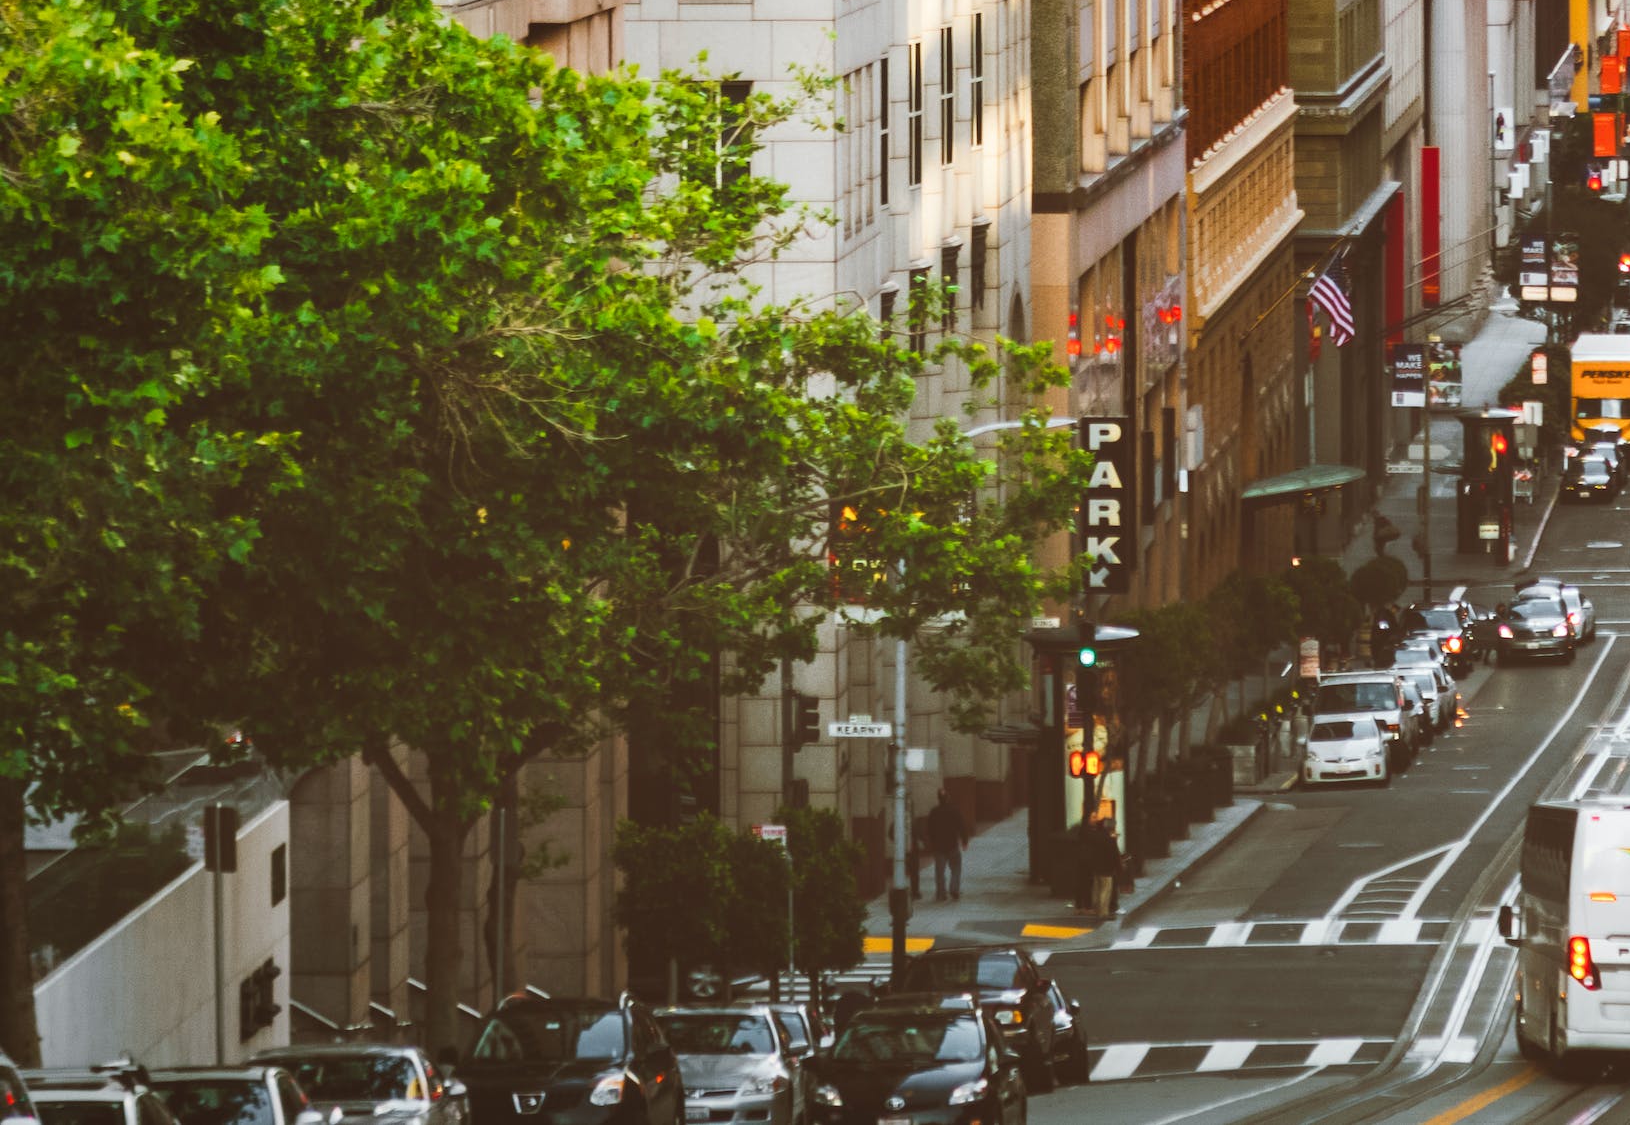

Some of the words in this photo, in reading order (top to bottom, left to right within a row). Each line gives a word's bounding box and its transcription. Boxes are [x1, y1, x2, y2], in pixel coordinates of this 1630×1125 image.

[1407, 354, 1422, 362] WE
[1395, 361, 1422, 369] MAKE
[1087, 423, 1123, 565] PARK
[837, 725, 883, 735] KEARNY
